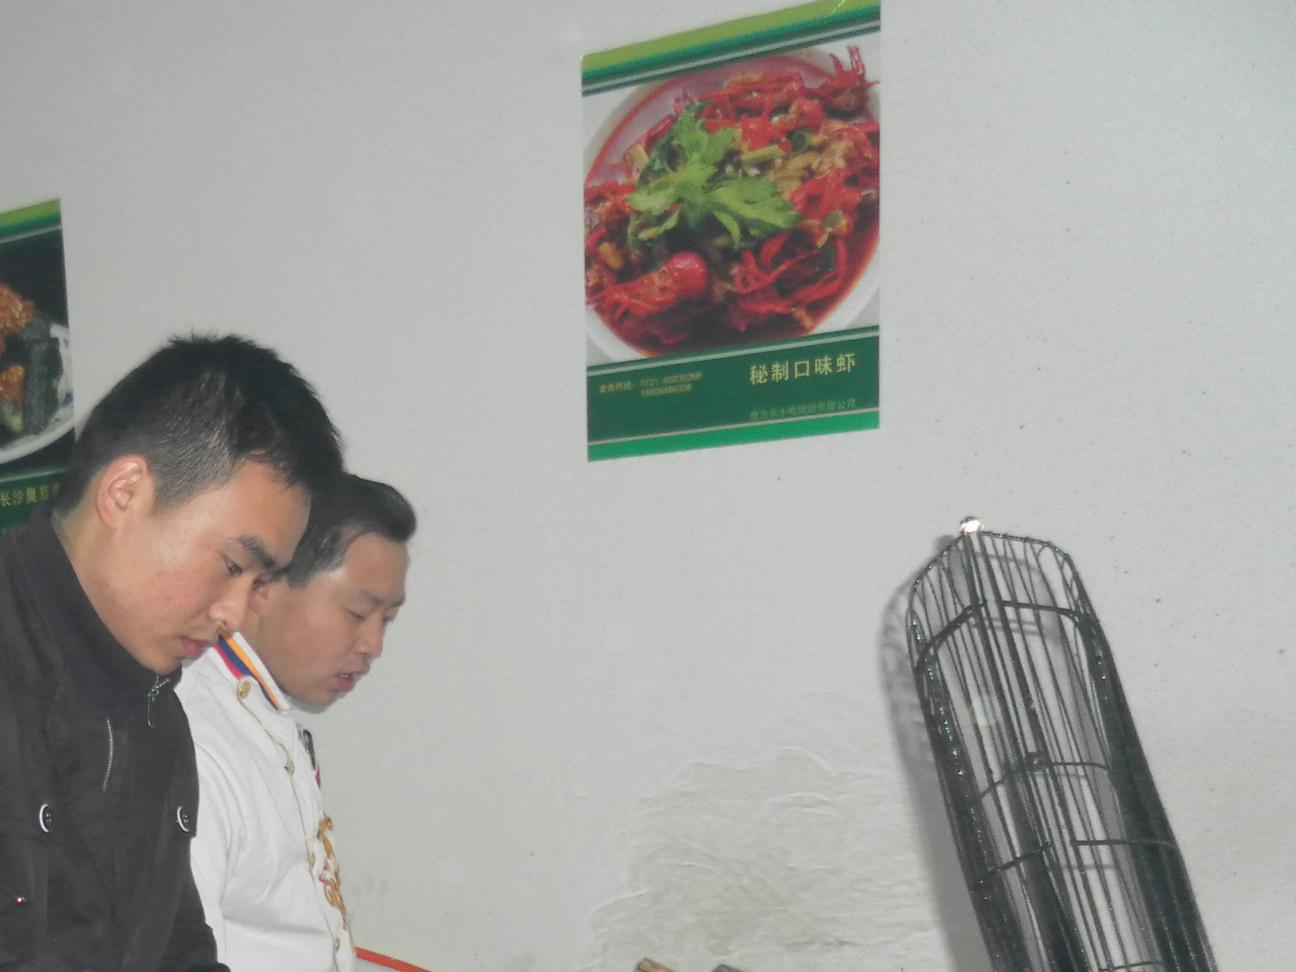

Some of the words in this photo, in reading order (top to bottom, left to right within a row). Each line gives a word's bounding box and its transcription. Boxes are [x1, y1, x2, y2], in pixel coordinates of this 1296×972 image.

[749, 352, 857, 386] 秘制口味虾
